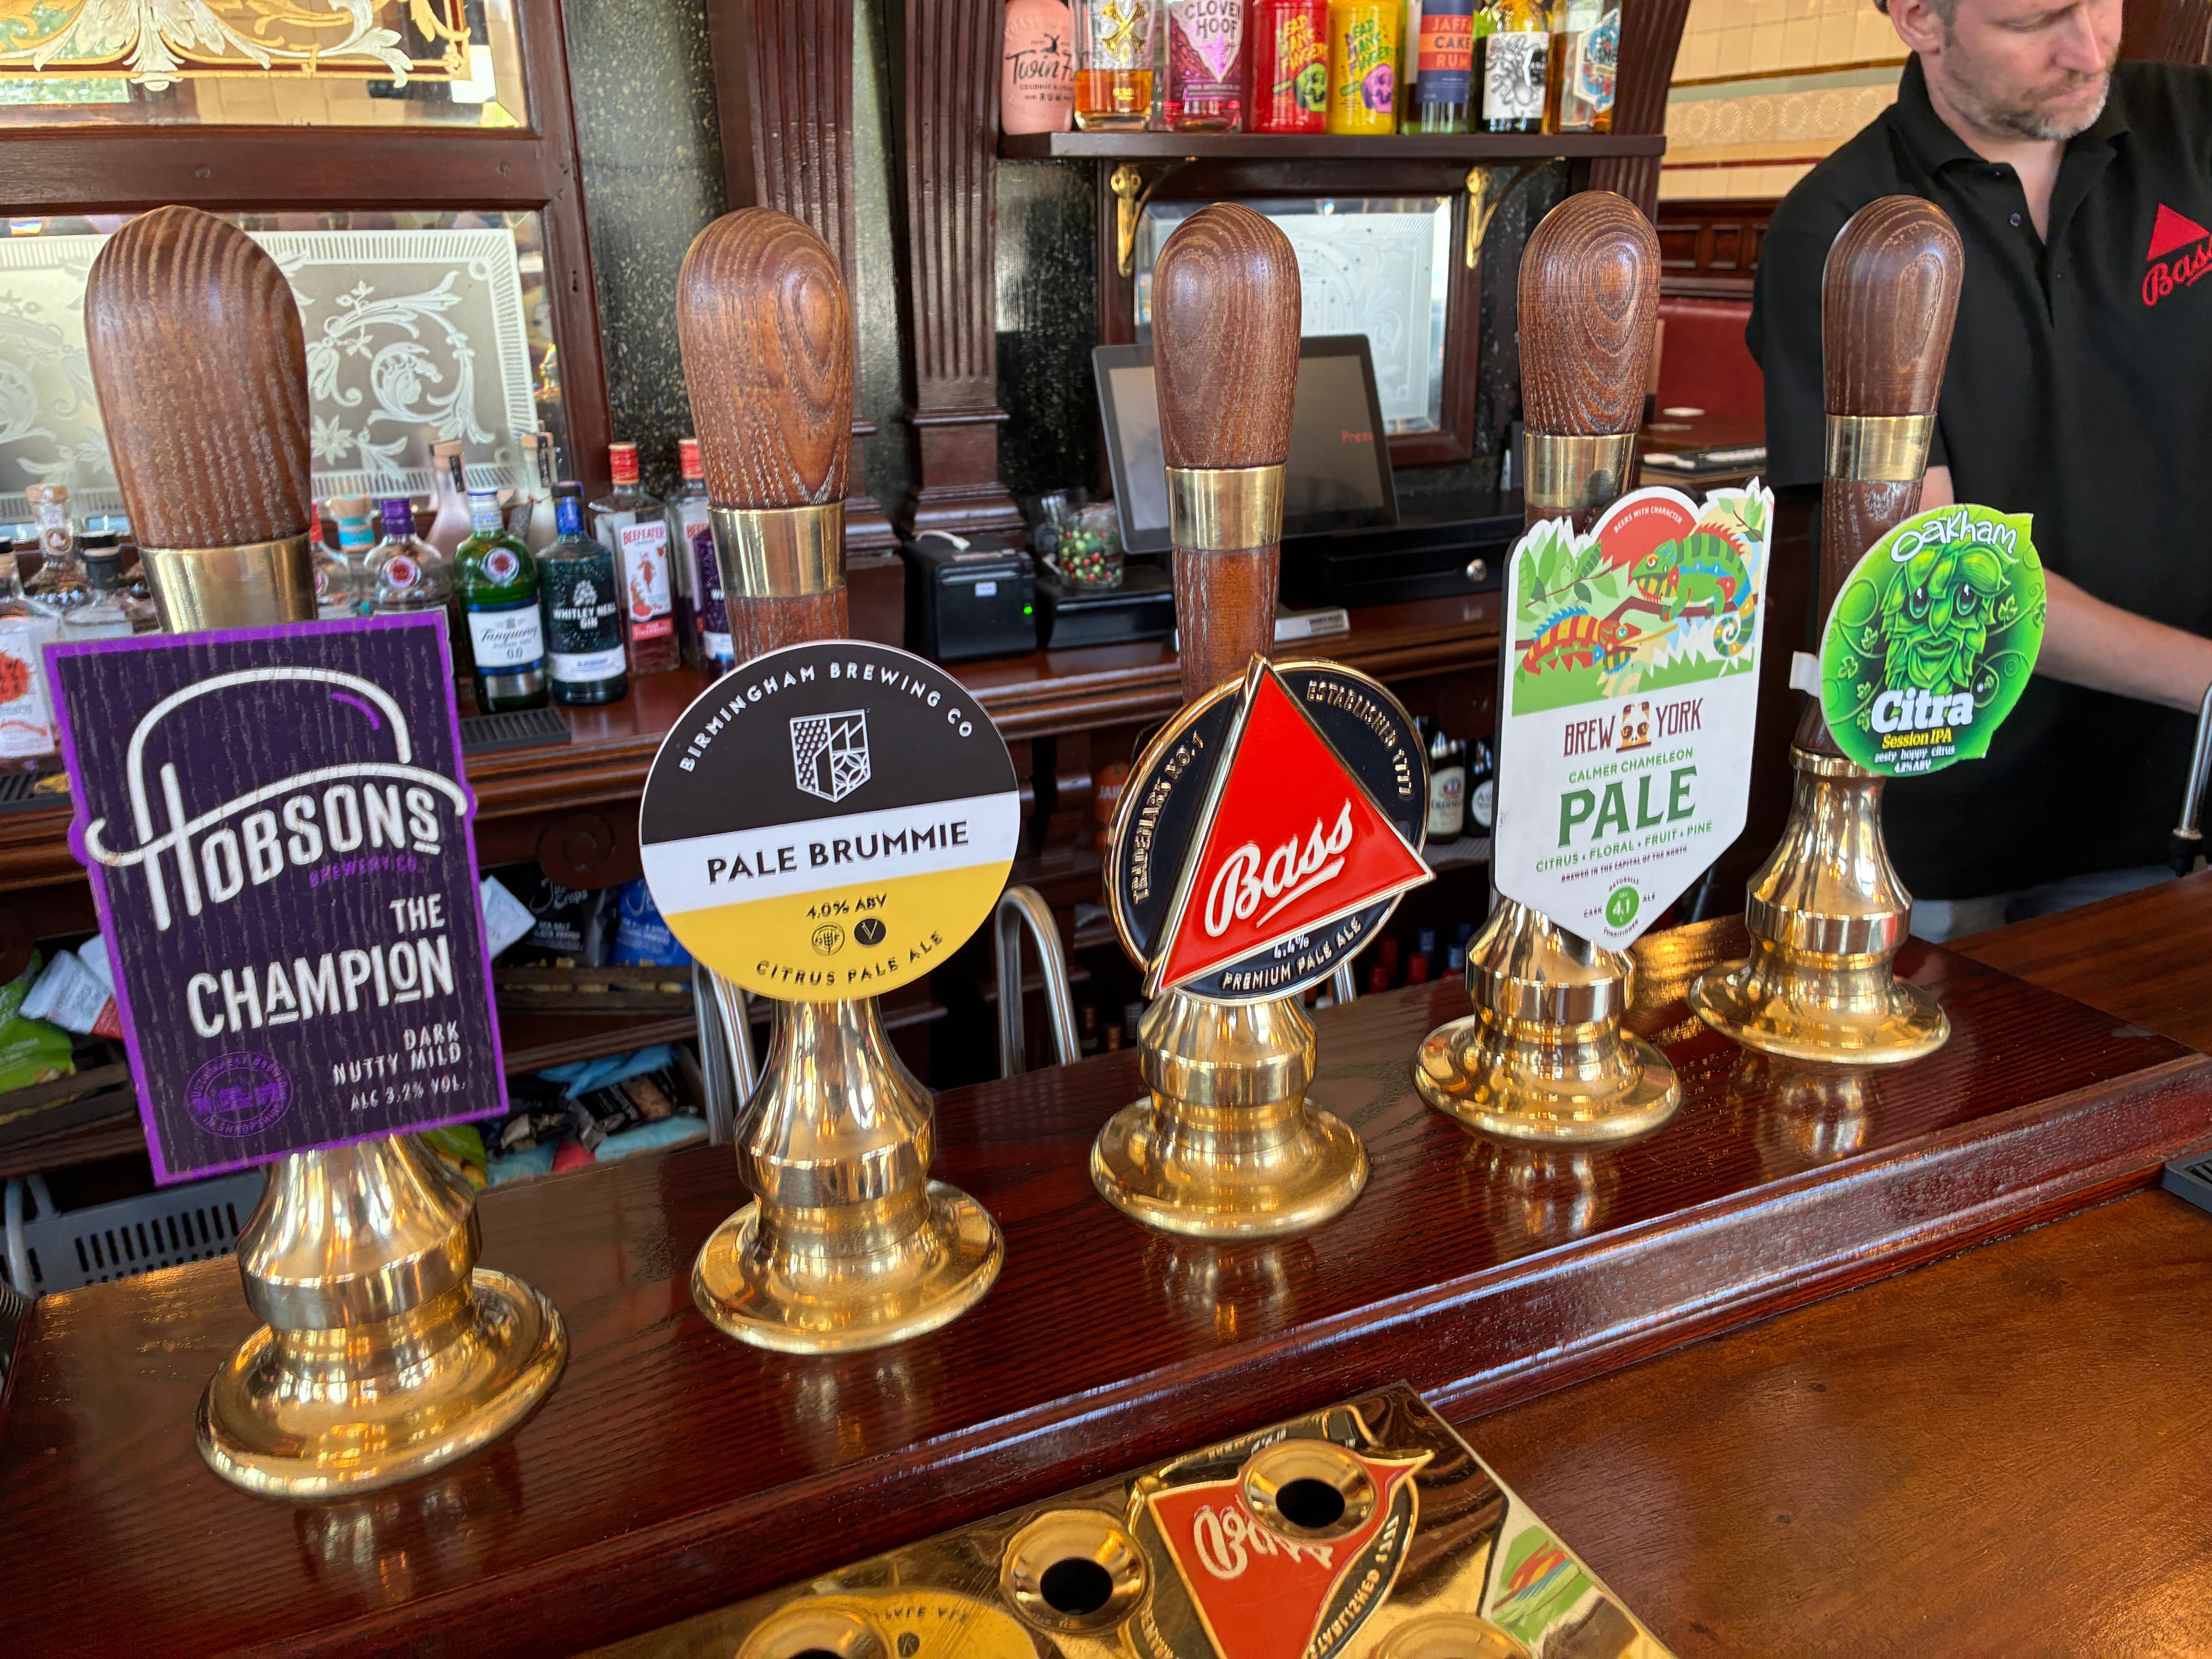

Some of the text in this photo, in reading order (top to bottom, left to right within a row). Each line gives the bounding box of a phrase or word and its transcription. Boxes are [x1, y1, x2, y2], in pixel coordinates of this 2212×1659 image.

[1005, 49, 1060, 85] Twin
[1613, 506, 1682, 534] BEERS WITH CHARACTER
[1890, 510, 2017, 562] Oakham
[679, 662, 972, 772] BIRMINGHAM BREWING CO
[1306, 680, 1398, 749] ESTABLISHED
[1563, 698, 1704, 757] BREW YORK
[1871, 687, 1974, 734] Citra
[1882, 727, 1952, 749] Session IPA
[1900, 748, 1928, 761] hoppy
[1931, 745, 1955, 757] citrus
[1568, 746, 1694, 784] CALMER CHAMELEON
[1557, 765, 1697, 849] PALE
[84, 762, 468, 931] HOBSONS
[707, 819, 970, 885] PALE BRUMMIE
[1205, 798, 1352, 937] Bass
[1536, 819, 1713, 873] CITRUS FLORAL FRUIT PINE
[1561, 844, 1687, 883] BREWED IN THE CAPITAL OF THE NORTH
[389, 893, 445, 934] THE
[806, 893, 887, 919] 4.0% ABV
[757, 930, 943, 986] CITRUS PALE ALE
[1222, 916, 1361, 991] PREMIUM PALE ALE
[186, 934, 454, 1038] CHAMPION
[403, 1019, 460, 1050] DARK
[332, 1042, 461, 1085] NUTTY MILD
[350, 1089, 379, 1112] ALC
